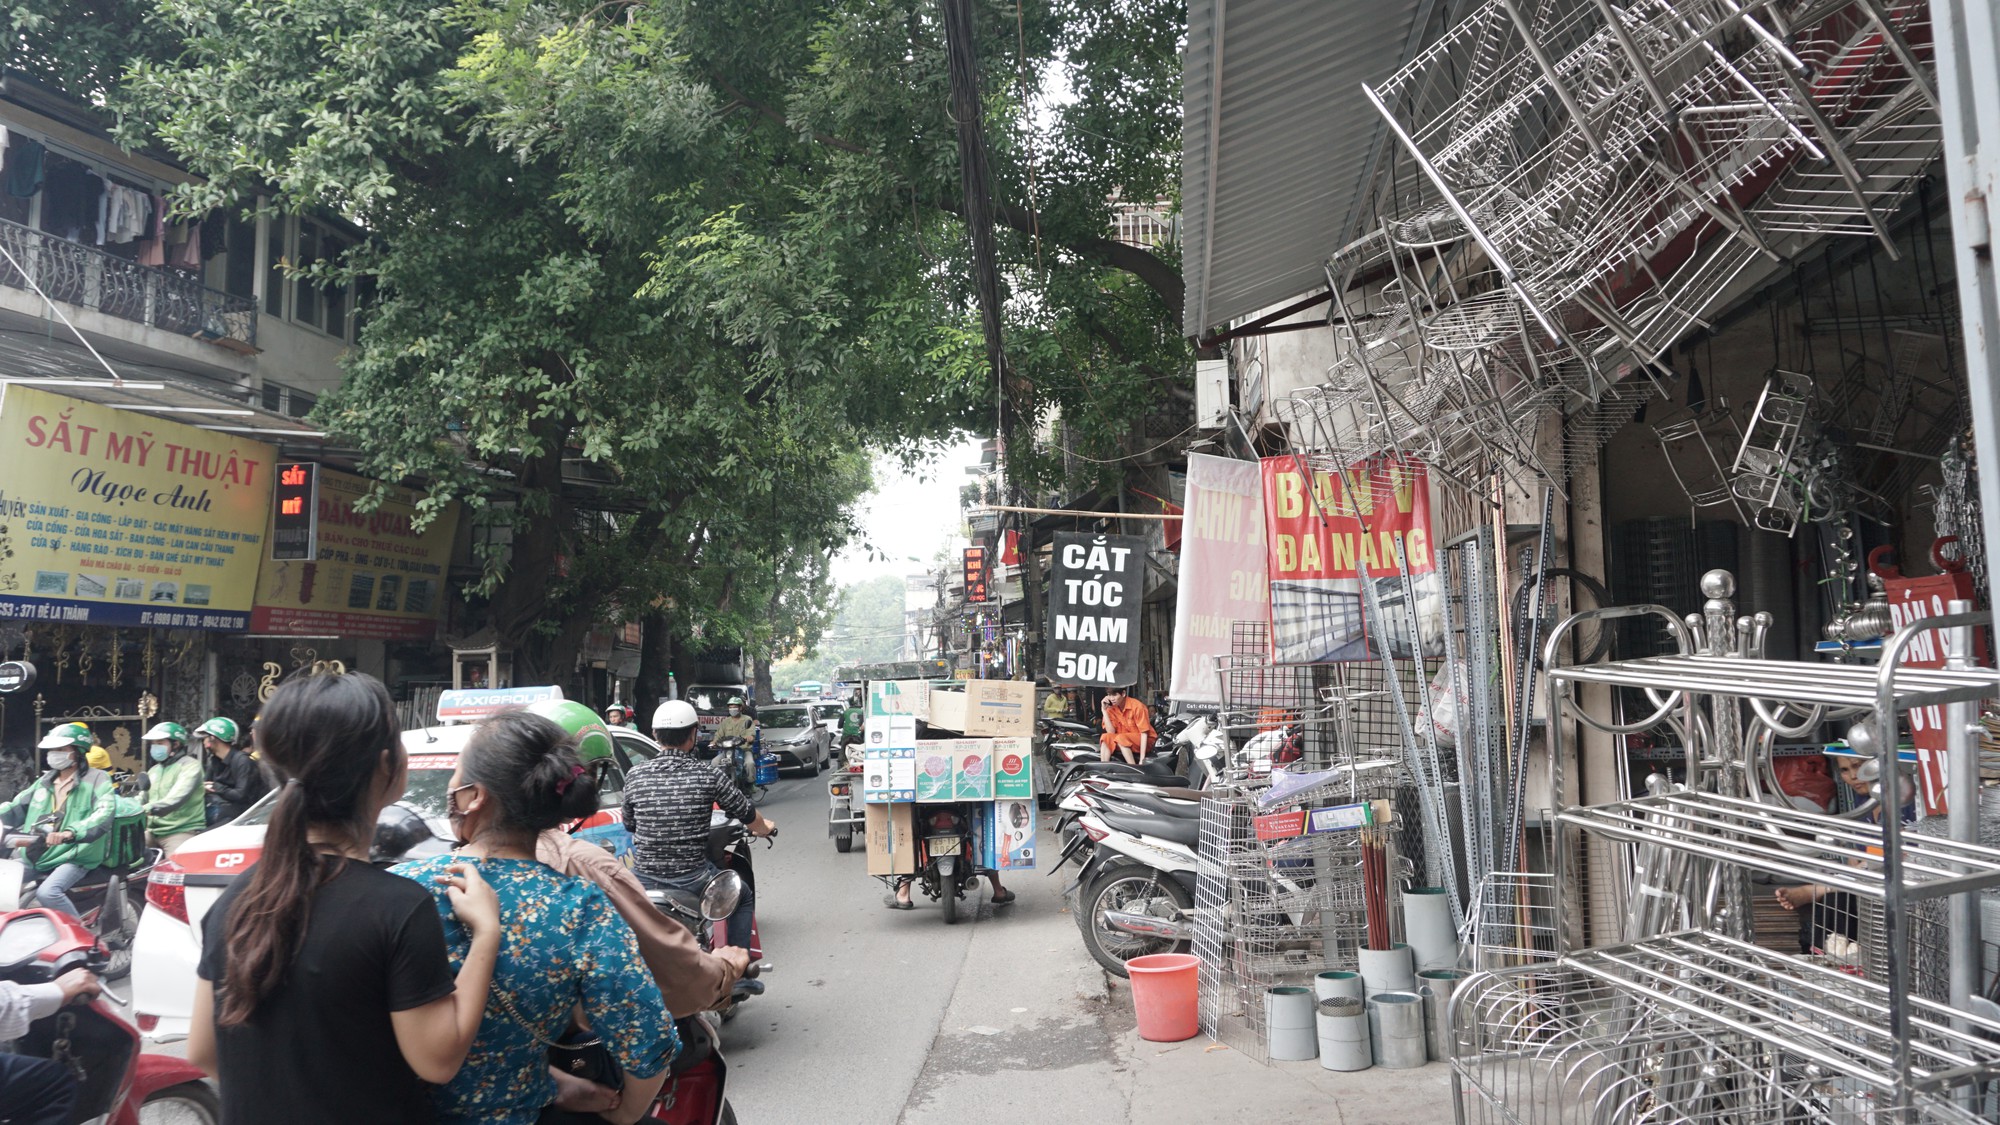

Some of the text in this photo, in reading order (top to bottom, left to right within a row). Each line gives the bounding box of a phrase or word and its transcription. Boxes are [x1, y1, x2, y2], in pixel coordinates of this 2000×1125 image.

[25, 406, 259, 490] SẮT MỸ THUẬT
[71, 467, 211, 512] Ngọc Anh
[281, 464, 307, 485] SẮT
[29, 501, 47, 516] SẢN
[48, 504, 70, 519] XUẤT
[76, 510, 89, 522] GIA
[91, 511, 112, 526] CÔNG
[118, 514, 132, 527] LẮP
[153, 519, 167, 532] CÁC
[184, 525, 202, 538] HÀNG
[281, 497, 303, 515] MỸ
[26, 517, 43, 531] CỬA
[45, 520, 68, 534] CỔNG
[75, 523, 90, 537] CỬA
[92, 528, 107, 540] HOA
[109, 529, 124, 541] SẮT
[146, 533, 165, 547] CÔNG
[171, 538, 184, 549] LAN
[185, 540, 199, 551] CAN
[214, 543, 235, 554] THANG
[31, 534, 47, 548] CỬA
[70, 541, 91, 554] HÀNG
[93, 542, 109, 555] RÀO
[115, 546, 132, 558] XÍCH
[1276, 524, 1429, 572] ĐA NĂNG
[1062, 536, 1131, 572] CẮT
[1065, 574, 1123, 607] TÓC
[20, 603, 36, 618] 371
[50, 606, 61, 619] LA
[62, 604, 90, 621] THÀNH
[1055, 615, 1128, 643] NAM
[1056, 651, 1118, 683] 50k
[453, 693, 549, 706] TAXIGROUP
[215, 853, 245, 868] CP
